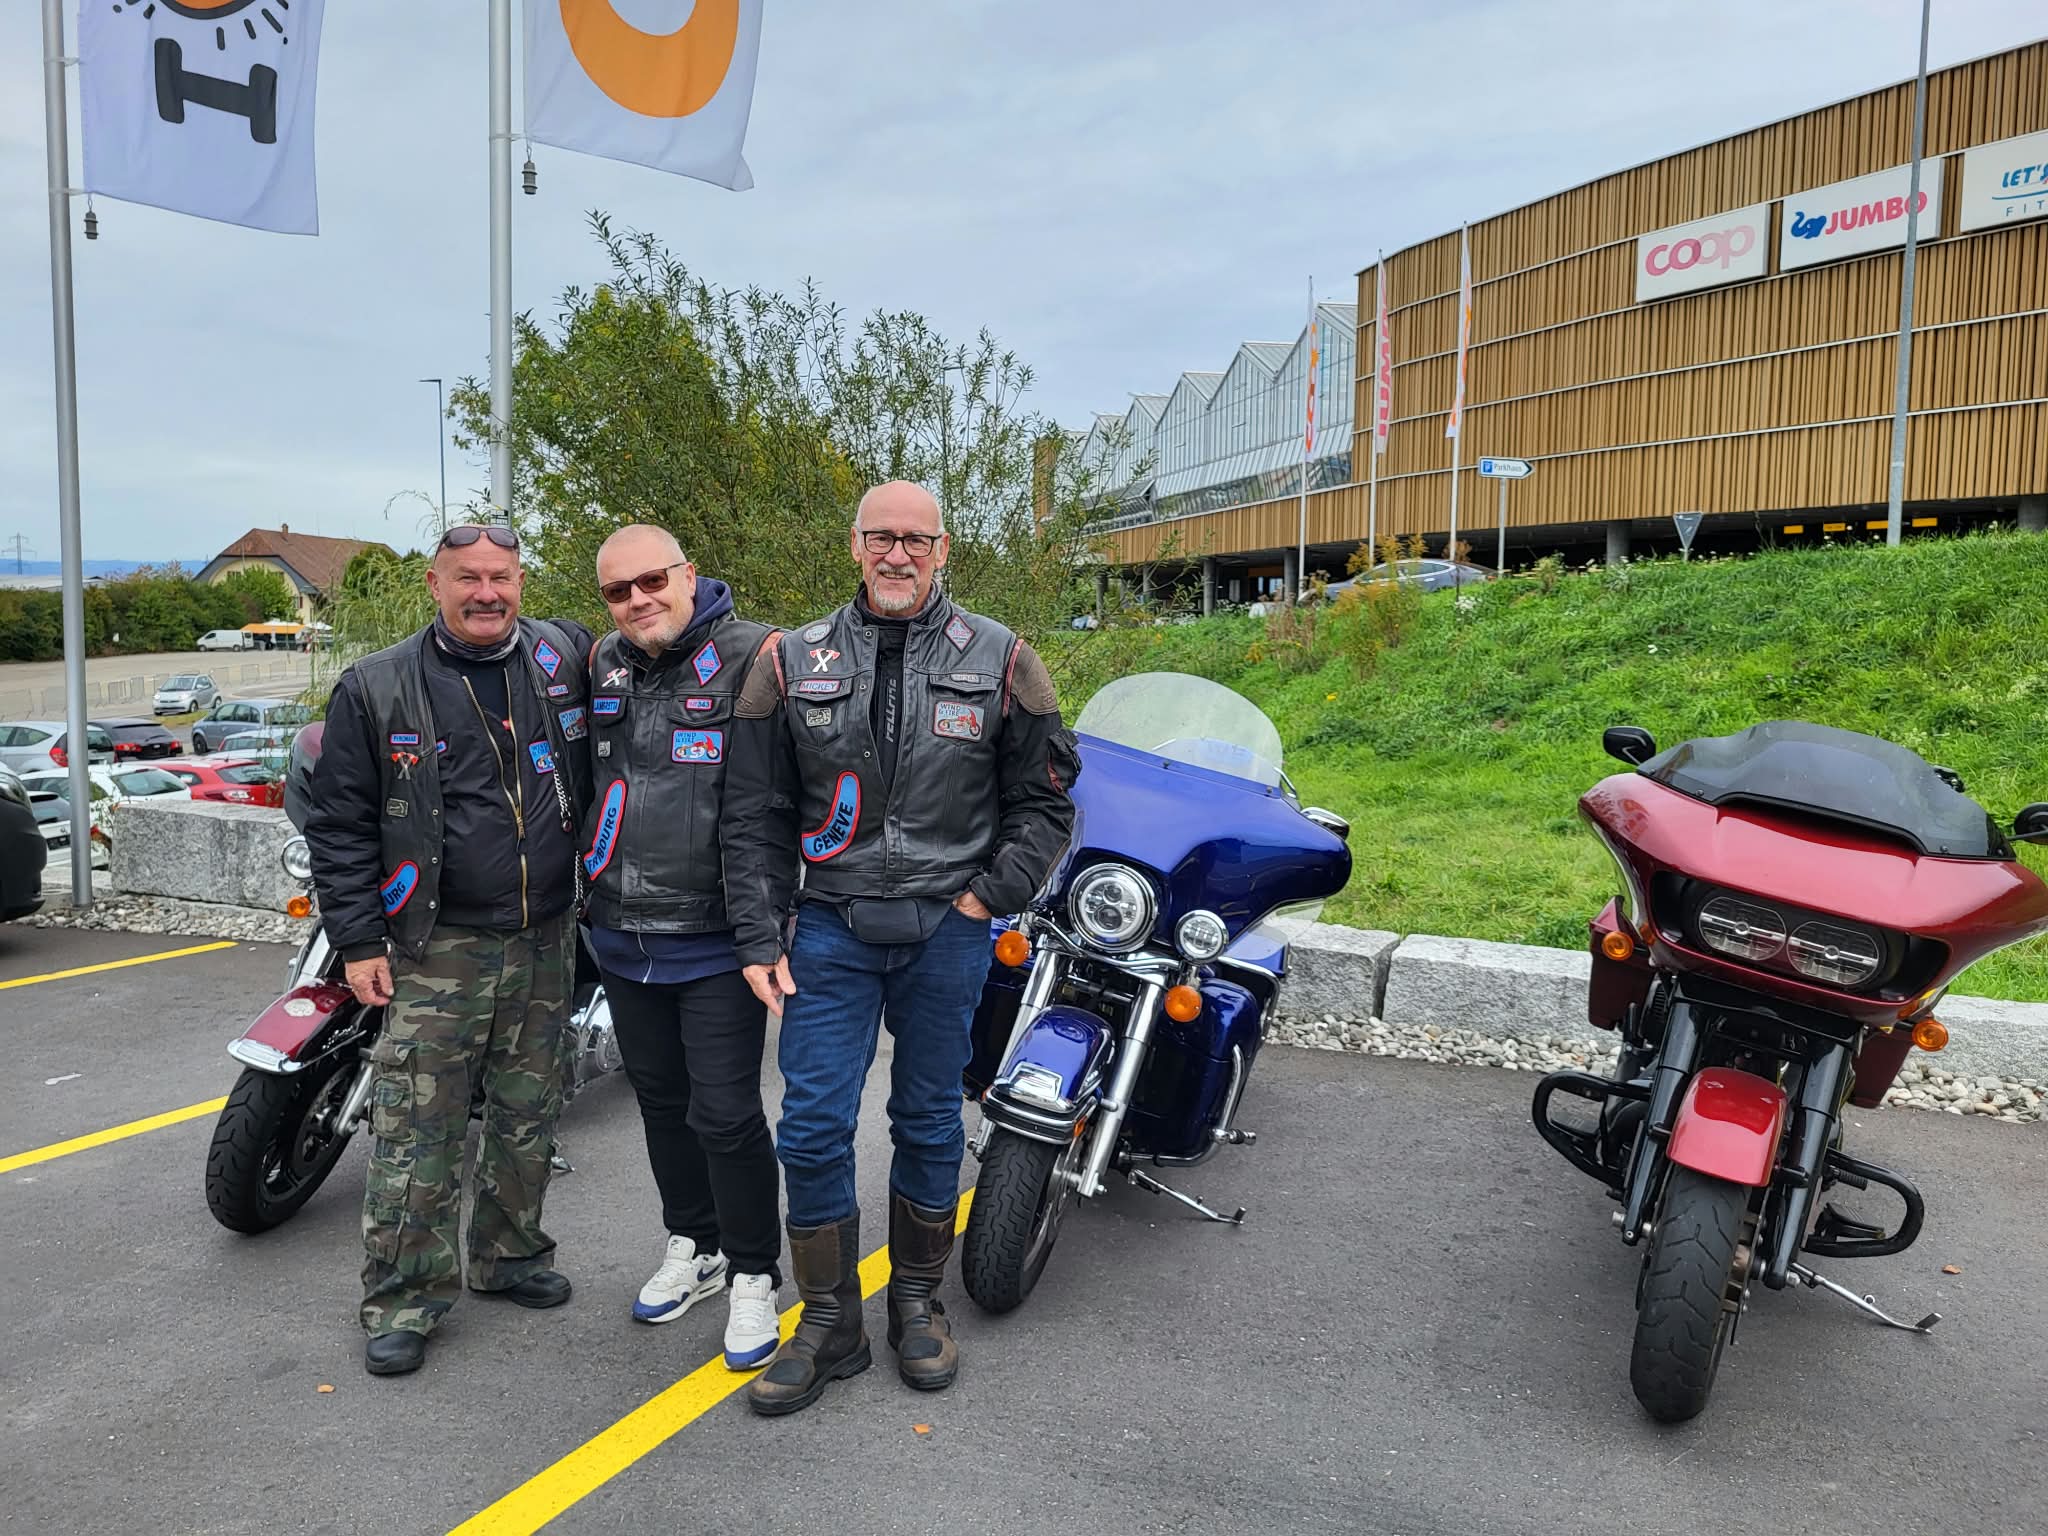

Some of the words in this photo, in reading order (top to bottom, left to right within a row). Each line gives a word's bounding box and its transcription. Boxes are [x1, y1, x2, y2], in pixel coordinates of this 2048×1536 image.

[1825, 191, 1928, 235] JUMBO
[1645, 225, 1755, 276] coop
[802, 682, 837, 691] MICKEY
[940, 703, 960, 711] WIND
[384, 881, 406, 907] URG
